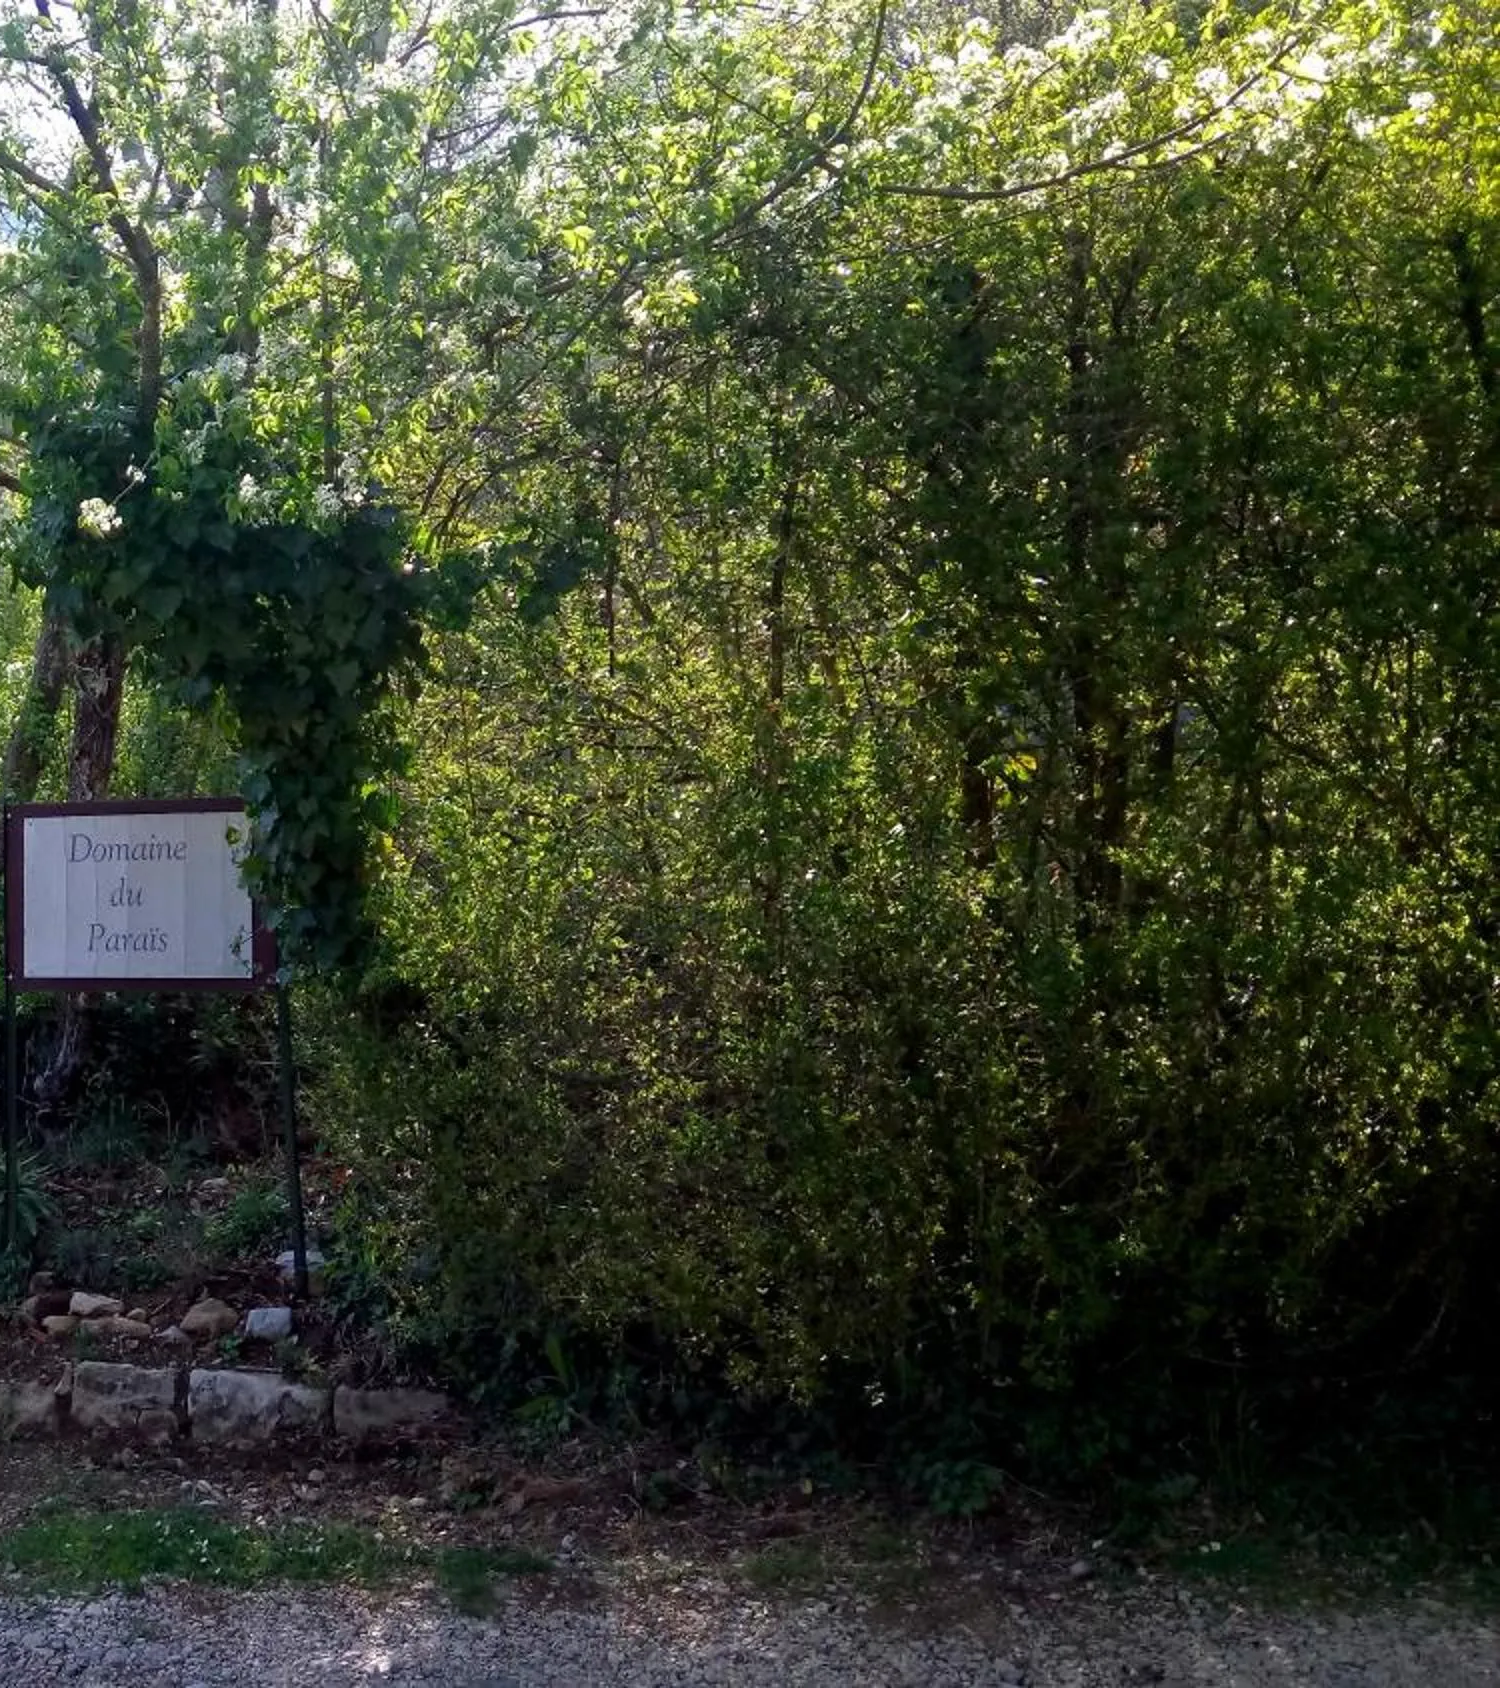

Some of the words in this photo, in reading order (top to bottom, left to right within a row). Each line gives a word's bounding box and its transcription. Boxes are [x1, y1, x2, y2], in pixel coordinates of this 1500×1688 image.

[68, 832, 188, 864] Domaine
[110, 876, 144, 907] du
[87, 922, 169, 954] Paraïs
